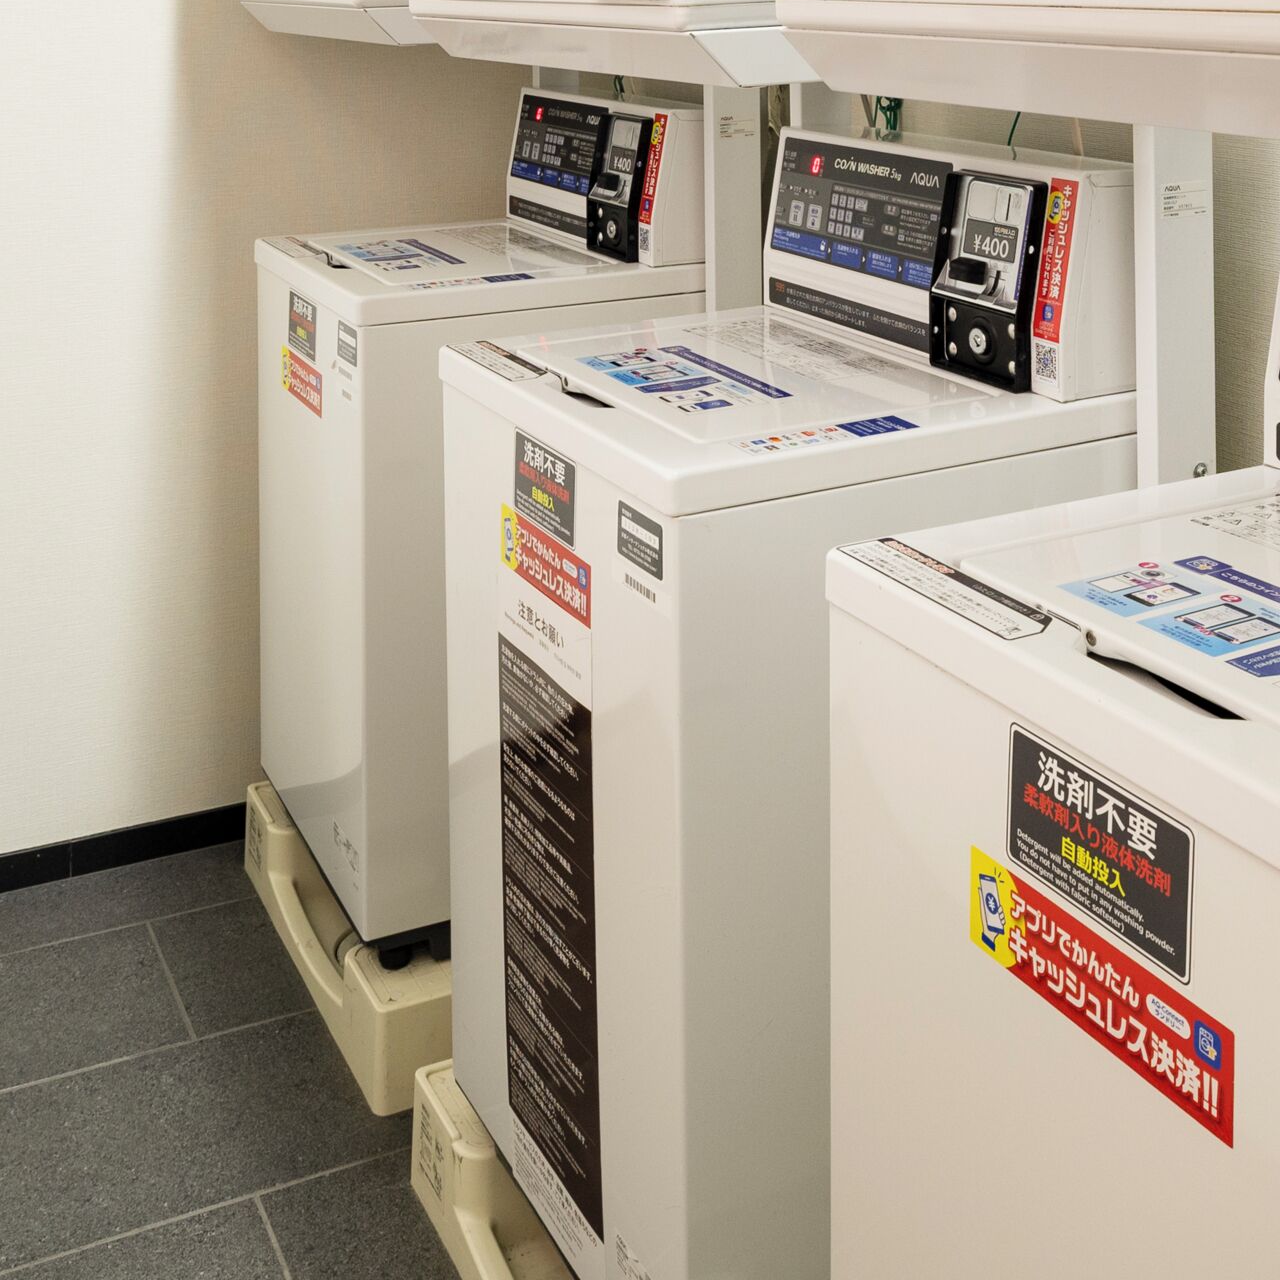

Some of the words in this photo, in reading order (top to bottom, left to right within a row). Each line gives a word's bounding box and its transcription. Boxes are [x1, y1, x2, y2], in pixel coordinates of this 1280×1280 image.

[613, 155, 632, 172] ¥400
[858, 160, 890, 178] WASHER
[890, 168, 902, 182] 5kg
[910, 172, 940, 188] AQUA
[973, 233, 1009, 258] ¥400
[1050, 185, 1072, 300] キャッシュレス決済
[523, 439, 566, 487] 洗剤不要
[531, 486, 555, 513] 自動投入
[515, 547, 587, 617] キャッシュレス決済!!
[518, 599, 565, 649] 注意とお願い
[1037, 751, 1158, 860] 洗剤不要
[1023, 783, 1171, 897] 柔軟剤入り液体洗剤
[1061, 836, 1126, 897] 自動投入
[1017, 827, 1048, 855] Detergent
[1049, 847, 1063, 862] will
[1072, 863, 1093, 886] added
[1094, 878, 1145, 923] automatically.
[1017, 838, 1029, 853] You
[1040, 854, 1052, 869] not
[1052, 862, 1069, 879] have
[1077, 878, 1090, 896] put
[1099, 893, 1112, 912] any
[1113, 902, 1144, 936] washing
[1145, 926, 1176, 956] powder.
[1019, 850, 1054, 883] (Detergent
[1055, 874, 1070, 891] with
[1071, 884, 1091, 908] fabric
[1091, 900, 1125, 933] softener)
[1011, 893, 1140, 1009] アプリでかんたん
[1009, 928, 1219, 1118] キャッシュレス決済!!
[1151, 997, 1186, 1028] AQ-Connect
[1154, 1009, 1182, 1032] ランドリー
